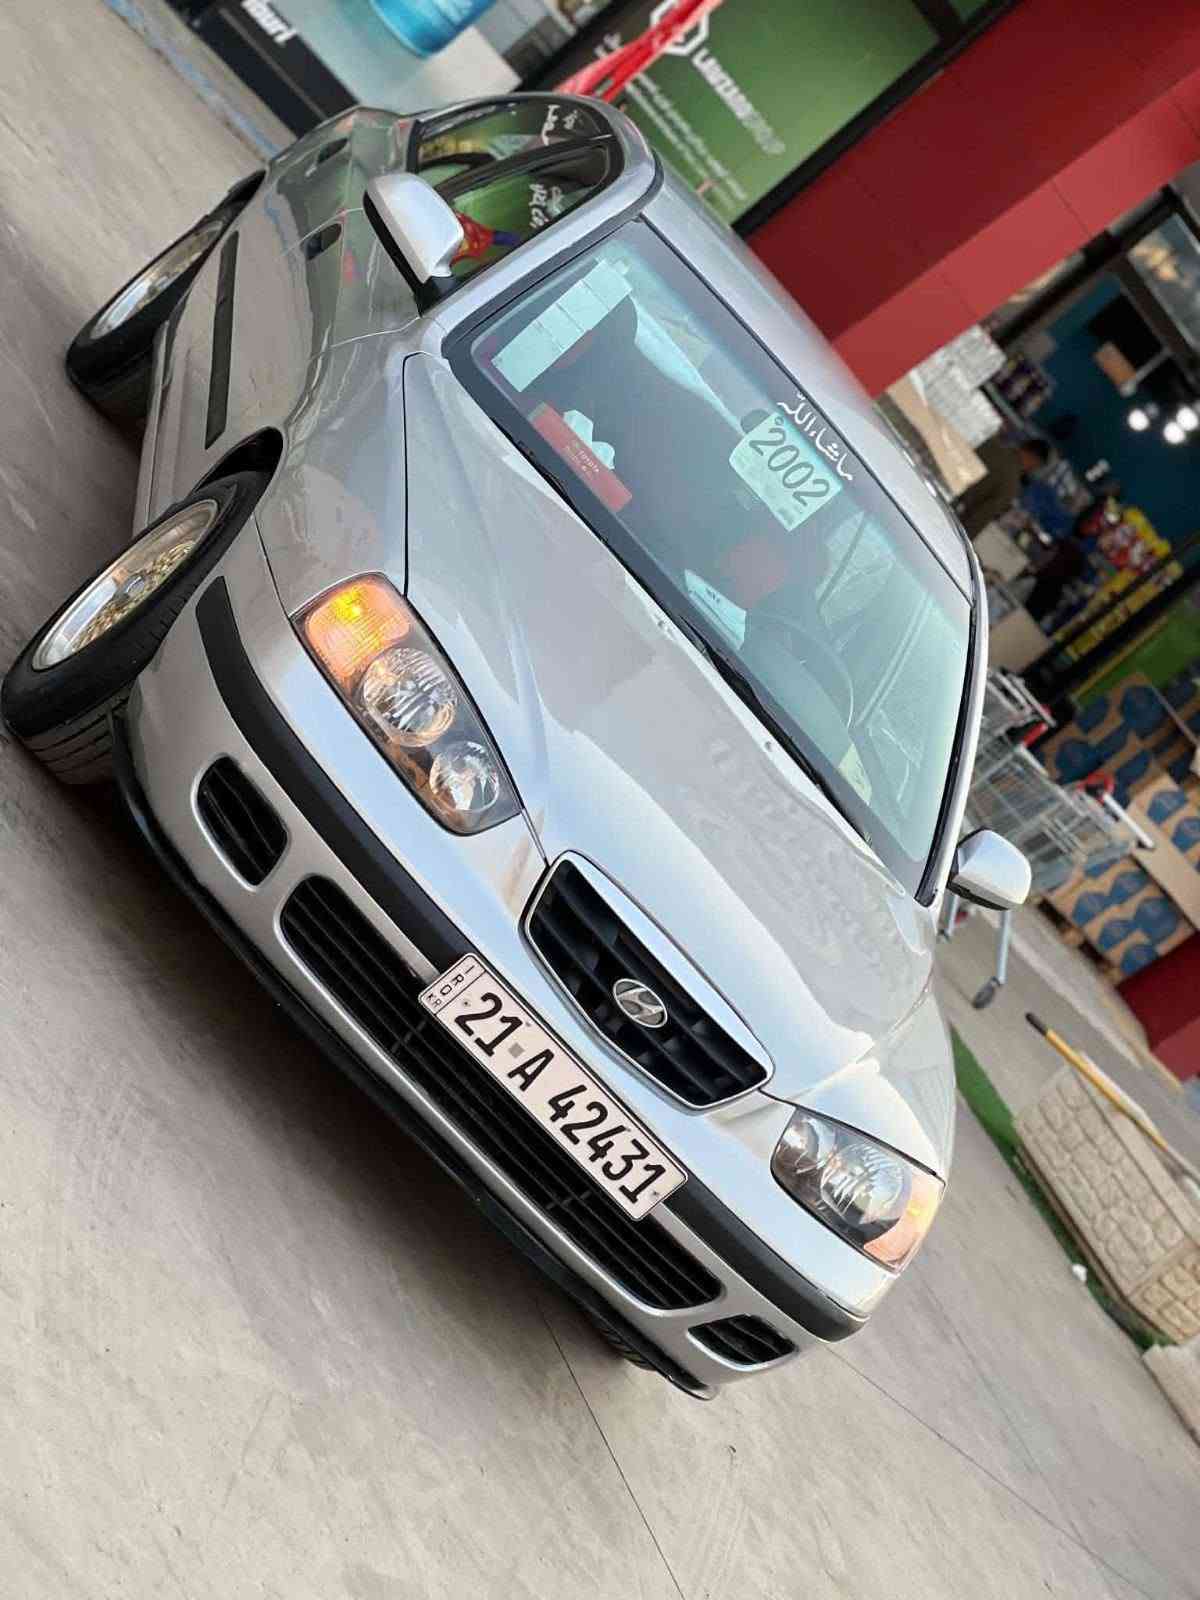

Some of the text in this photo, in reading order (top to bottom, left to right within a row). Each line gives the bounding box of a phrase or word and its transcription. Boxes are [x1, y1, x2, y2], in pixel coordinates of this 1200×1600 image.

[748, 427, 830, 507] 2002
[454, 991, 666, 1204] 21 A 42431
